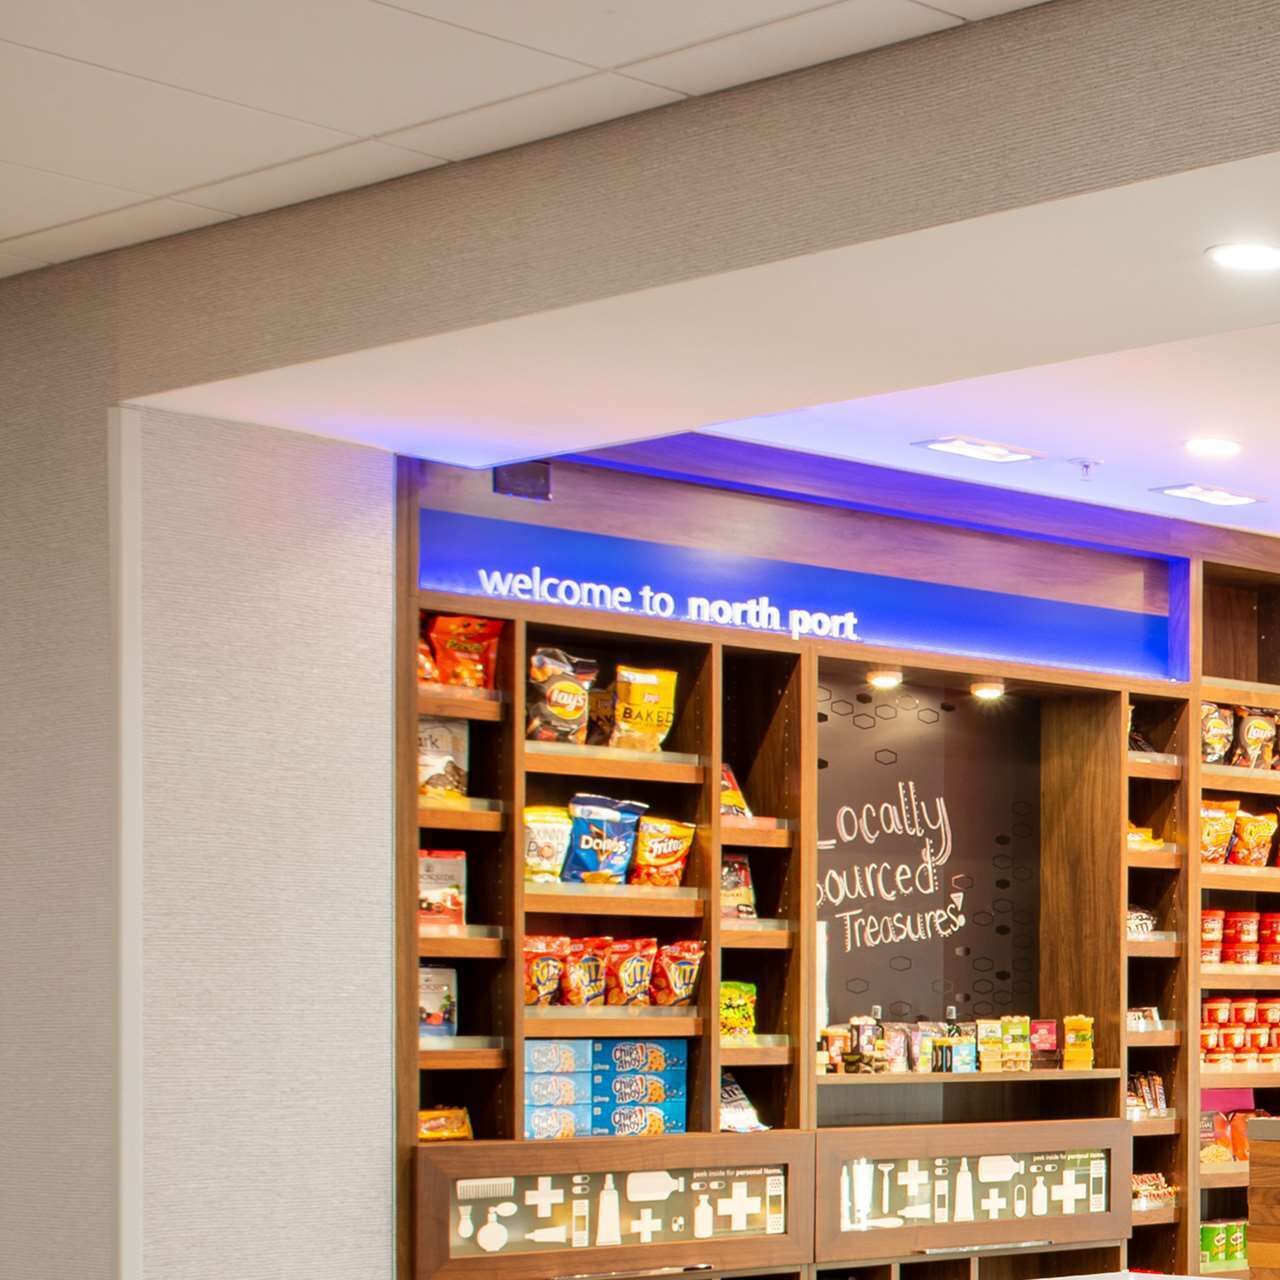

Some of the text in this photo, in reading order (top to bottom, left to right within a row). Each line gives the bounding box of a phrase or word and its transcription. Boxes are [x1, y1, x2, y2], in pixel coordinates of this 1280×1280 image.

[478, 566, 860, 640] welcome to north port
[622, 706, 674, 724] BAKED
[817, 781, 951, 866] ocally
